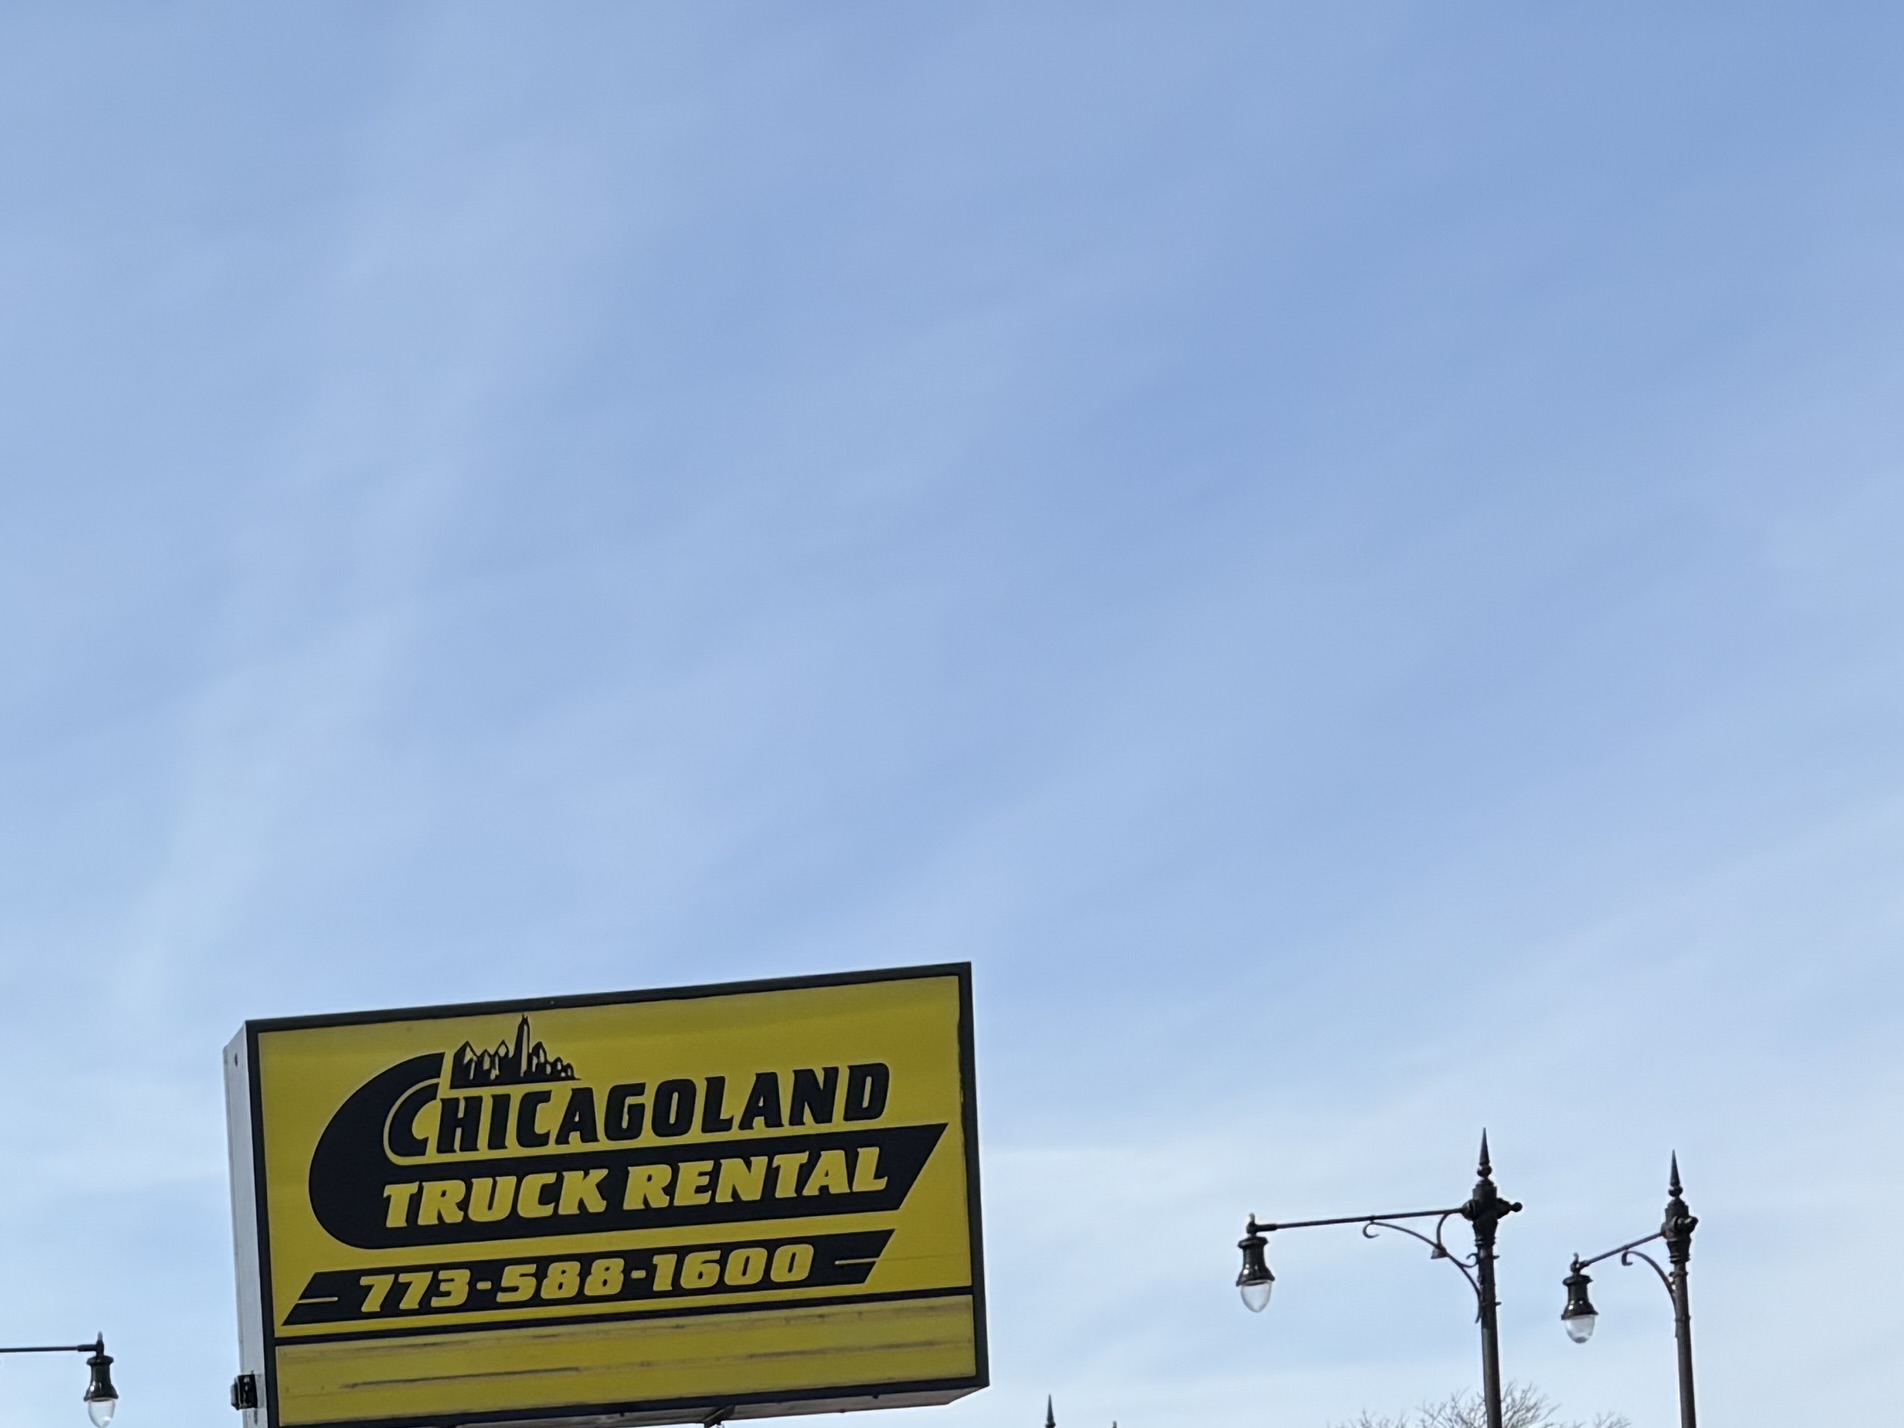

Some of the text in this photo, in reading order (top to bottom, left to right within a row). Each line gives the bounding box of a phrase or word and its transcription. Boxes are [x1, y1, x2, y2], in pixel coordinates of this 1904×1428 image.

[389, 1063, 889, 1157] CHICAGOLAND
[382, 1146, 889, 1229] TRUCK RENTAL
[359, 1243, 814, 1313] 773-588-1600
